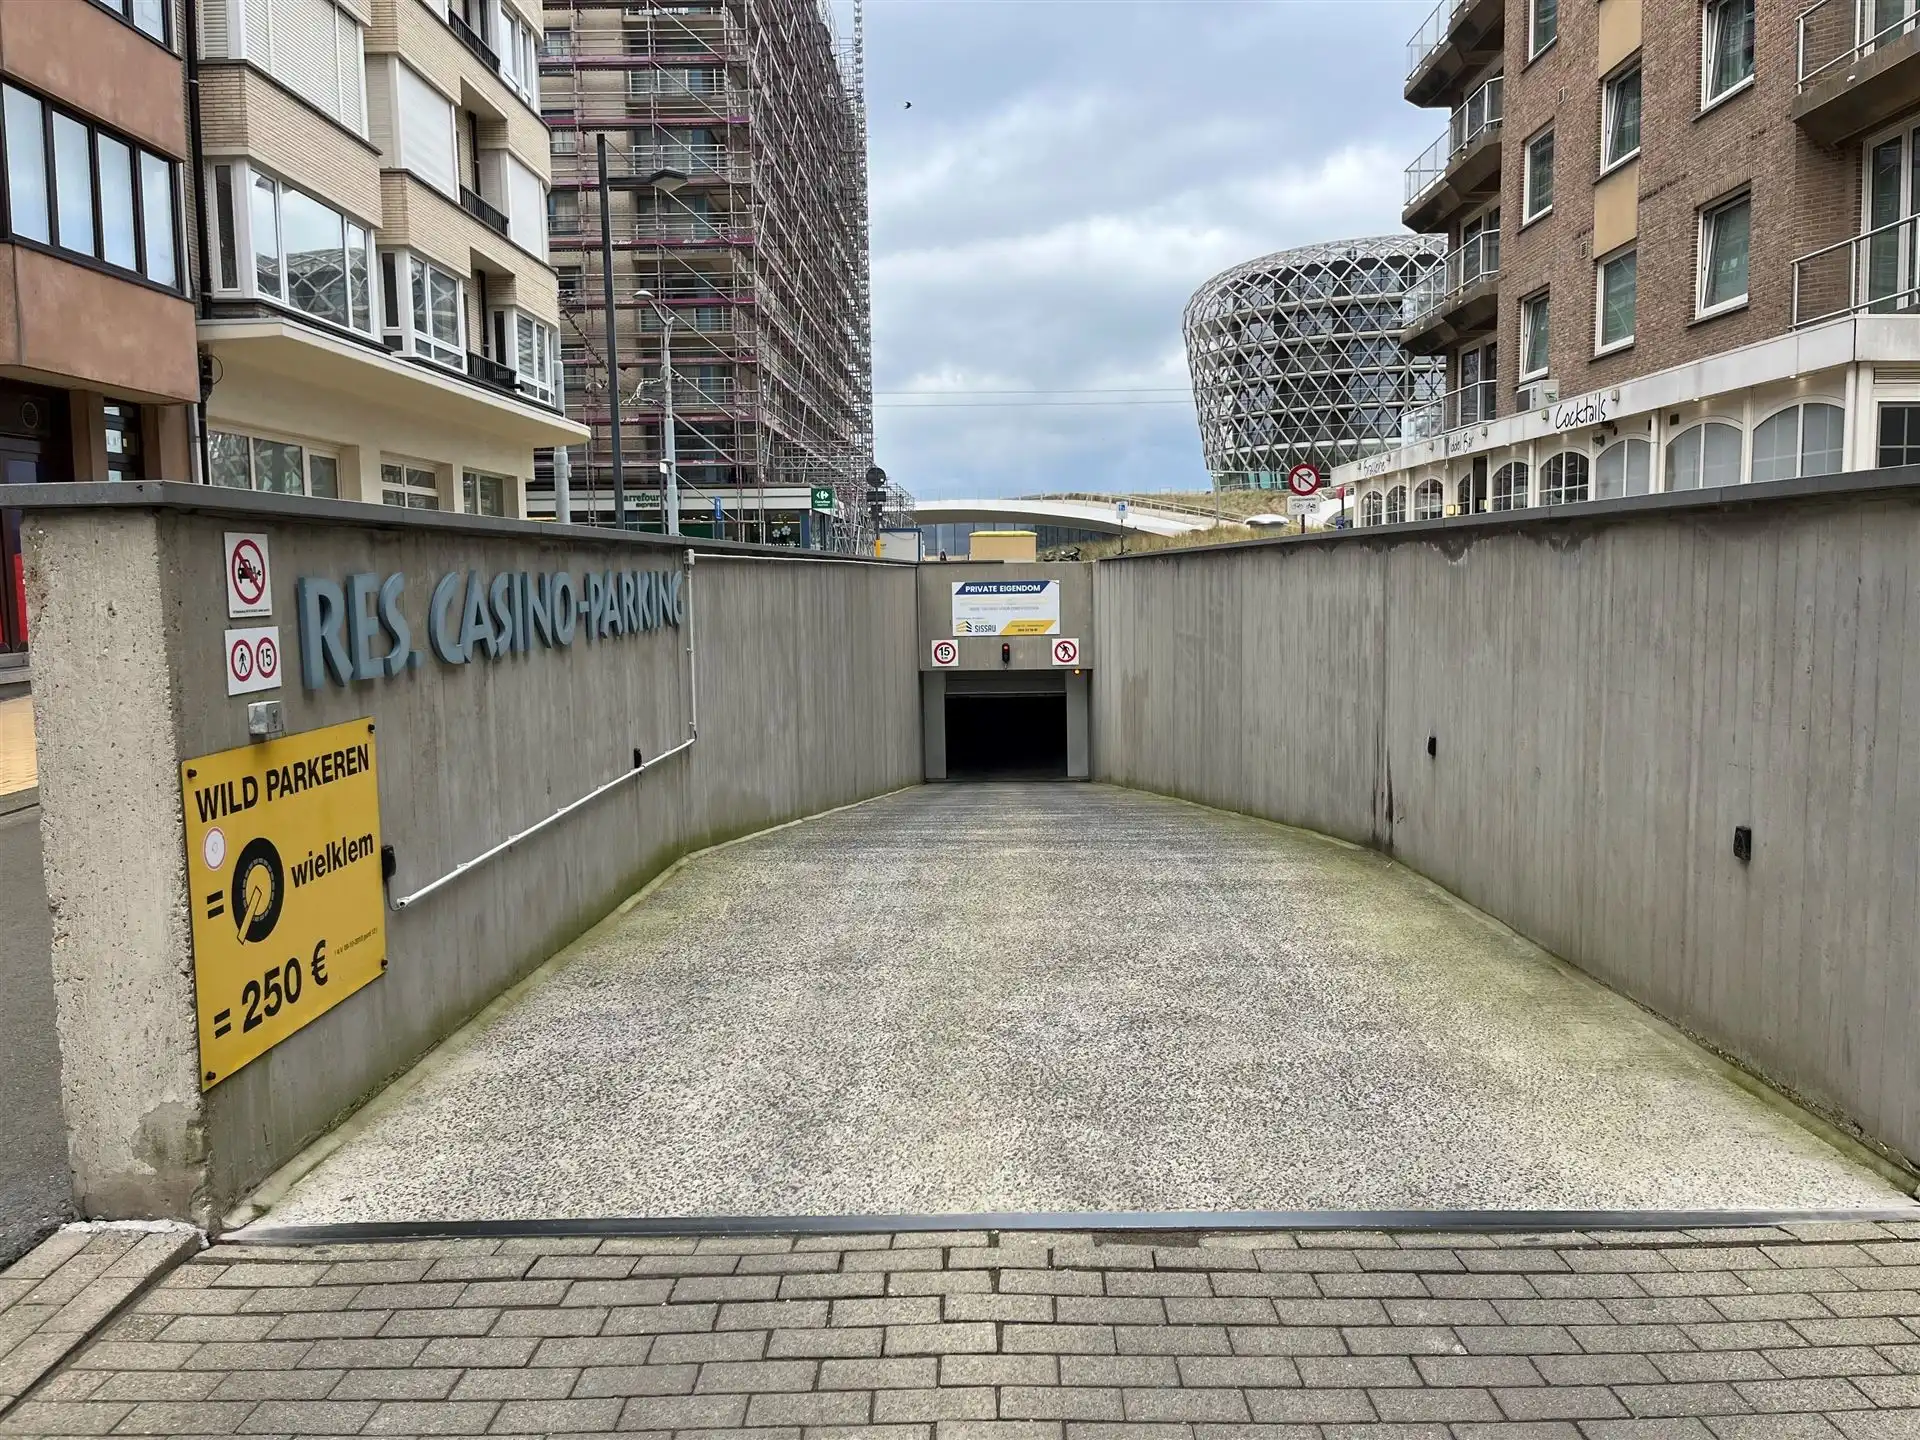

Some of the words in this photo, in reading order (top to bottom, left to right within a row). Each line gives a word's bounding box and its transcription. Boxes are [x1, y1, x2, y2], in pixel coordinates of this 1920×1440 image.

[1555, 392, 1606, 429] Cocktails
[623, 493, 660, 502] arrefour
[965, 585, 997, 593] PRIVATE
[999, 584, 1041, 592] EIGENDOM
[297, 571, 426, 690] RES.
[430, 569, 684, 665] CASINO-PARKING
[260, 648, 272, 667] 15
[938, 646, 950, 656] 15
[195, 775, 259, 823] WILD
[265, 743, 369, 801] PARKEREN
[291, 833, 374, 888] wielklem
[241, 957, 302, 1034] 250
[311, 939, 328, 986] €
